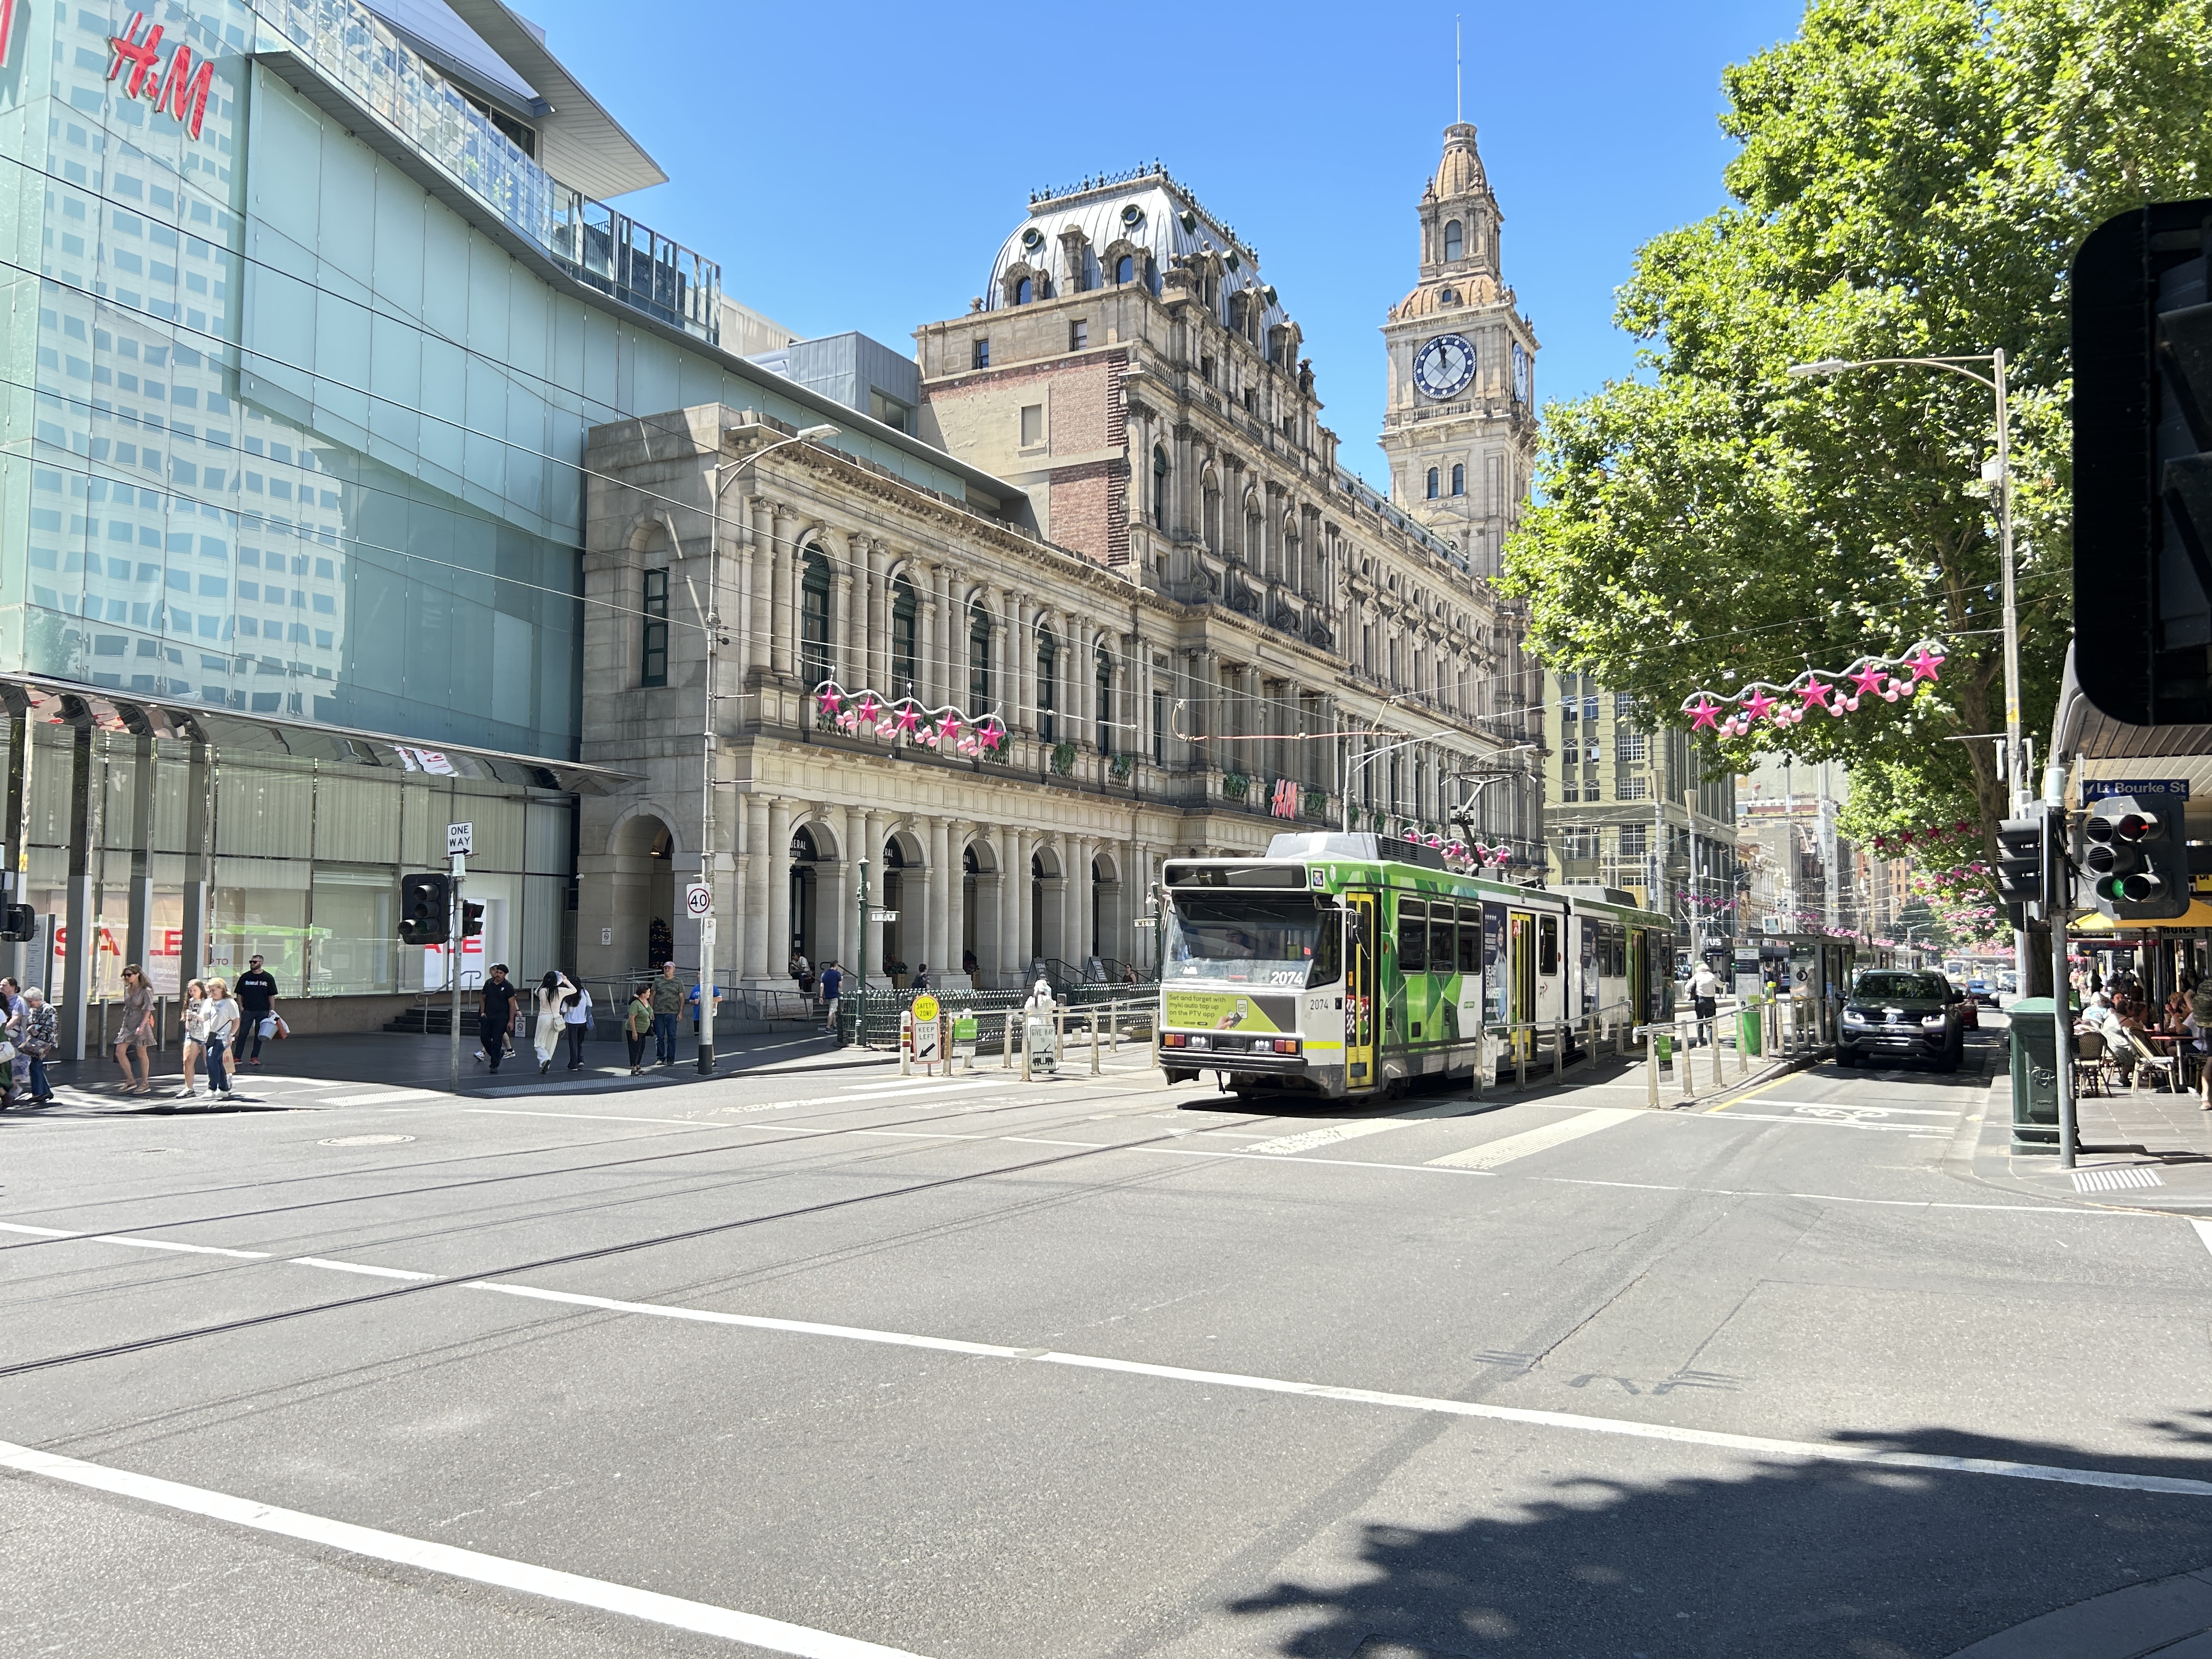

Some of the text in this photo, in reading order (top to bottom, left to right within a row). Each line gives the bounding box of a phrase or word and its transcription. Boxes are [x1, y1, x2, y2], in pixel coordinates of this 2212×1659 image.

[107, 10, 220, 142] H&M
[1723, 671, 1735, 679] 20
[2097, 781, 2186, 793] Lt Bourke St
[451, 825, 469, 836] ONE
[449, 836, 470, 847] WAY
[790, 839, 806, 850] DERAL
[690, 894, 707, 907] 40
[1270, 971, 1304, 985] 2074
[1310, 999, 1328, 1010] 2074
